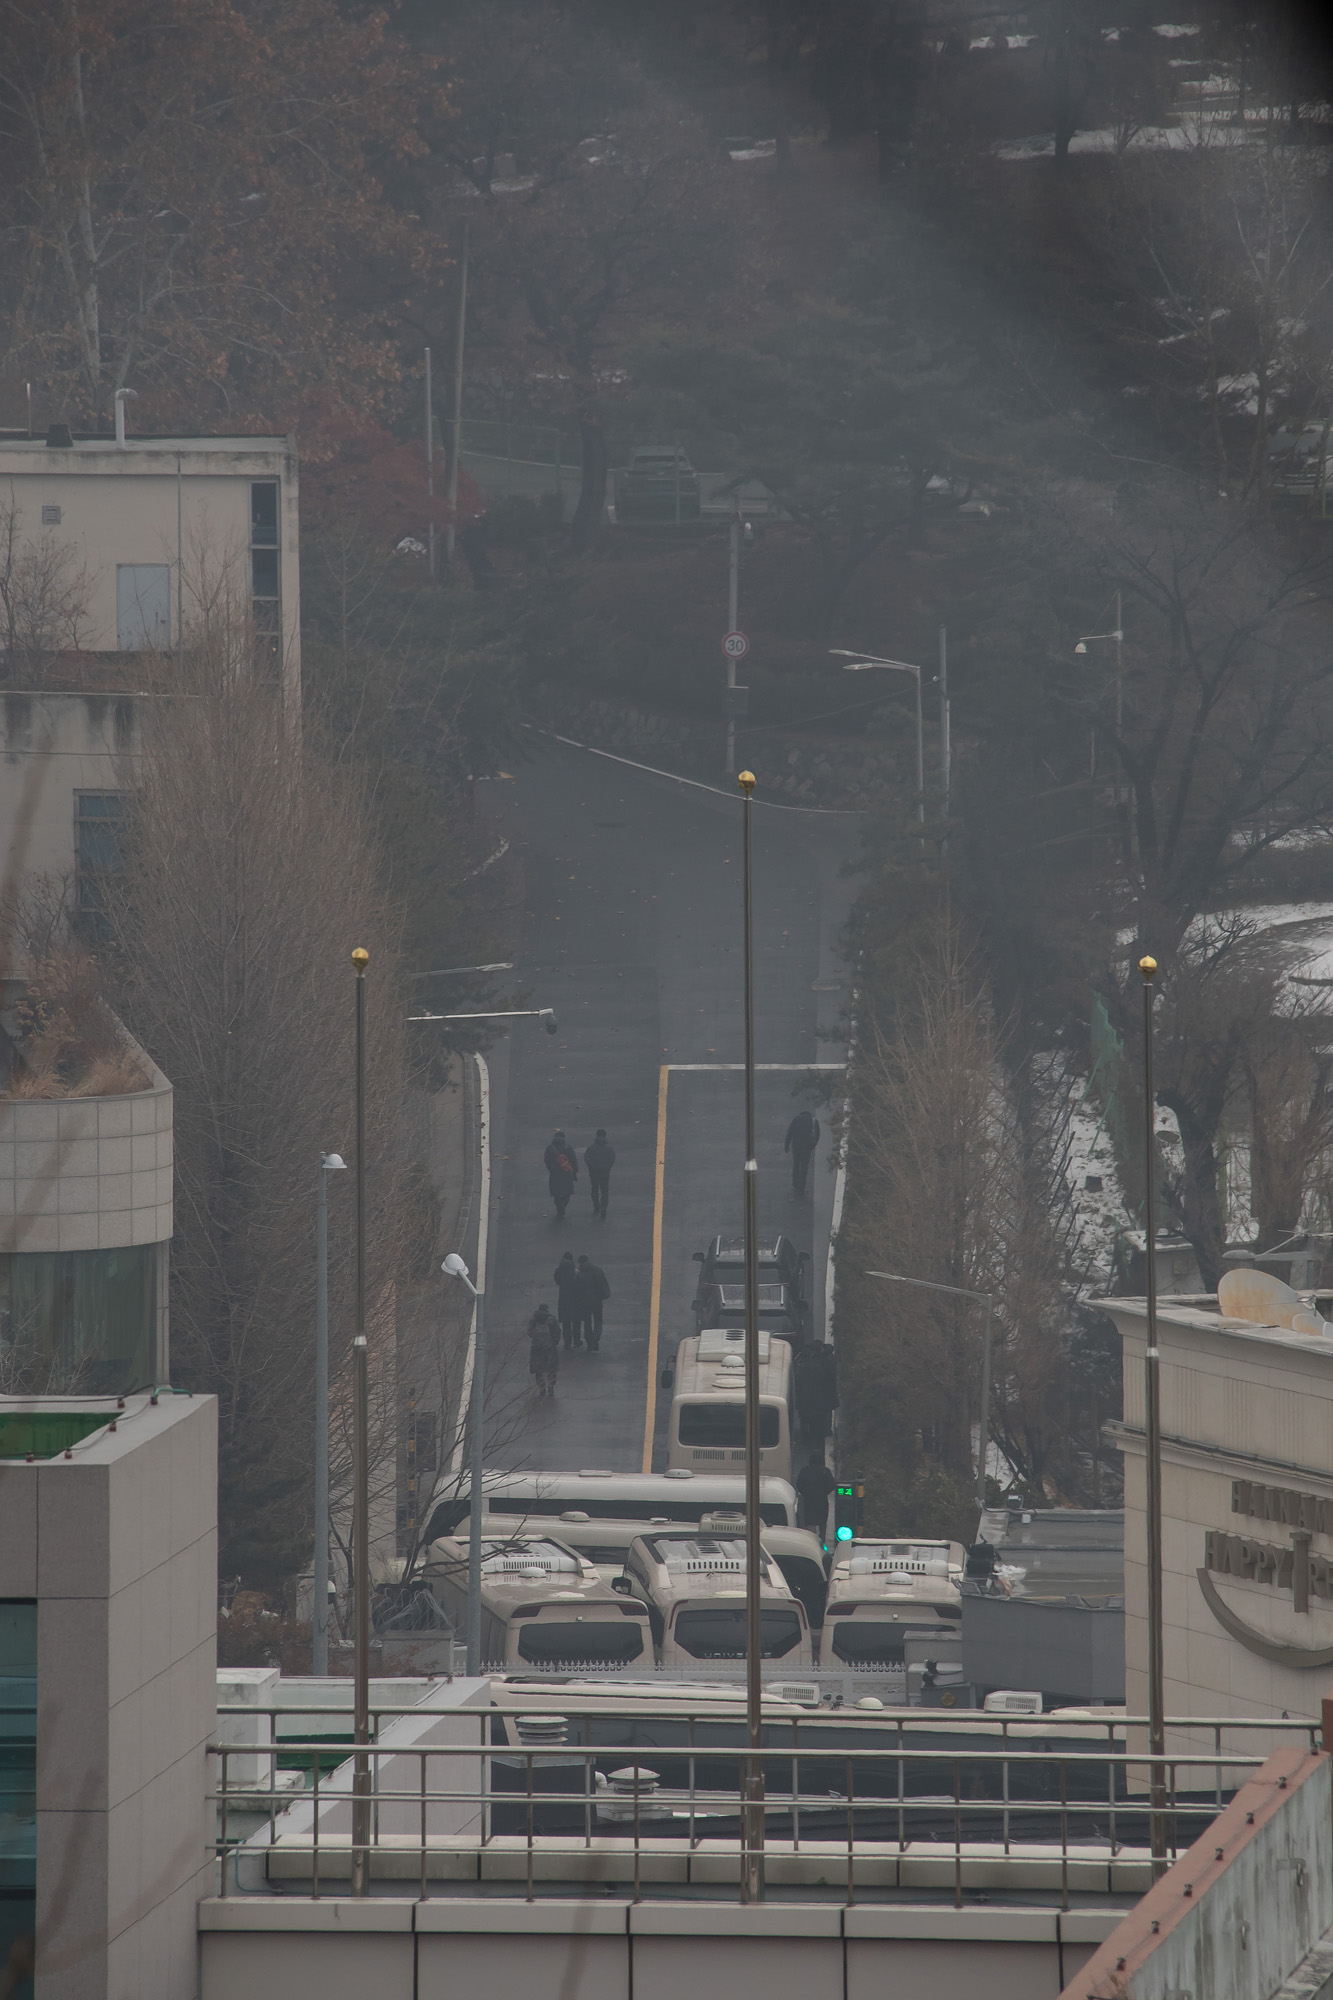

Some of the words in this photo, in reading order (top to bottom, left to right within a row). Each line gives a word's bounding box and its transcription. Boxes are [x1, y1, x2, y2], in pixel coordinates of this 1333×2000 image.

[728, 640, 744, 652] 30
[1231, 1480, 1333, 1534] HANNAM
[1205, 1530, 1294, 1588] HAPPY
